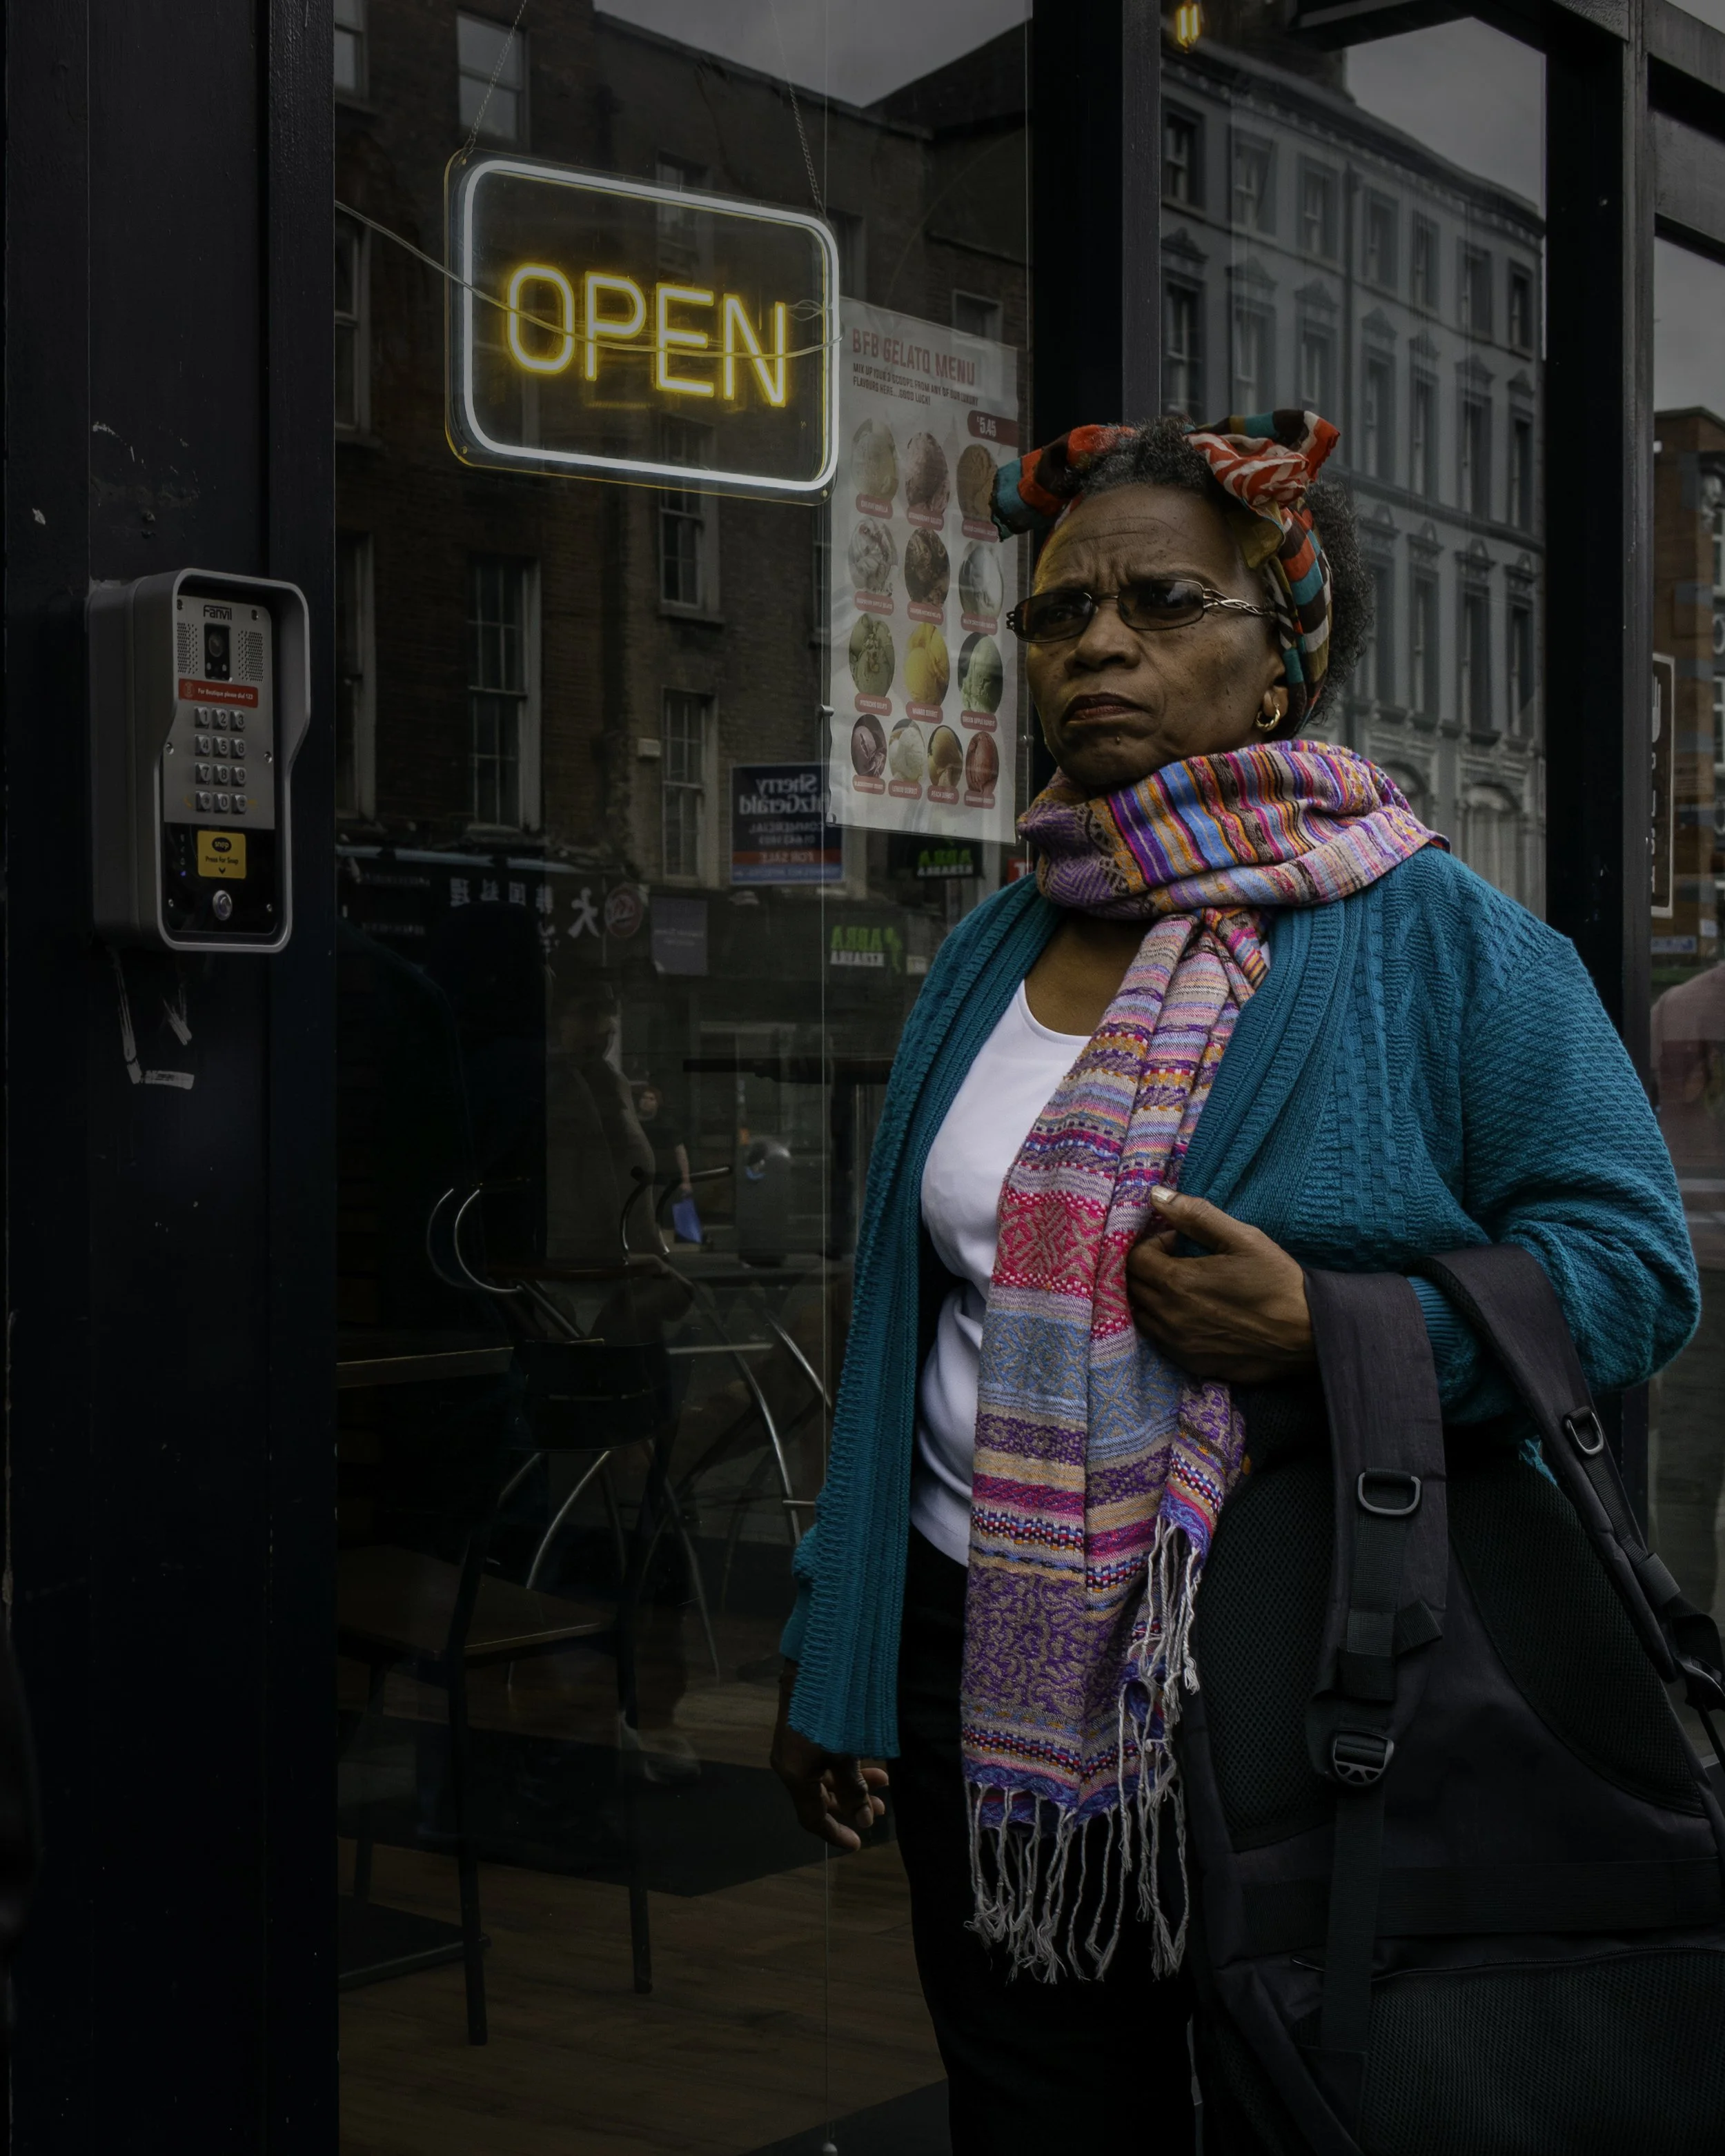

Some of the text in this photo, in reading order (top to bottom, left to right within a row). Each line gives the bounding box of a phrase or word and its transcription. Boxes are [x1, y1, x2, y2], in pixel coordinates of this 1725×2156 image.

[507, 262, 786, 407] OPEN
[853, 328, 975, 386] BFB GELATO MENU
[853, 363, 864, 373] MIX
[866, 365, 872, 375] UP
[914, 380, 930, 392] FROM
[931, 384, 941, 396] ANY
[943, 387, 949, 397] OF
[853, 376, 878, 391] FLAVOURS
[915, 393, 931, 406] LUCK!
[203, 604, 232, 620] Fanvil
[206, 689, 223, 697] Boutique
[224, 691, 237, 699] please
[204, 711, 244, 725] 1 2 3
[203, 739, 244, 753] 4 5 6
[203, 767, 244, 780] 7 8 9
[221, 795, 227, 807] 0
